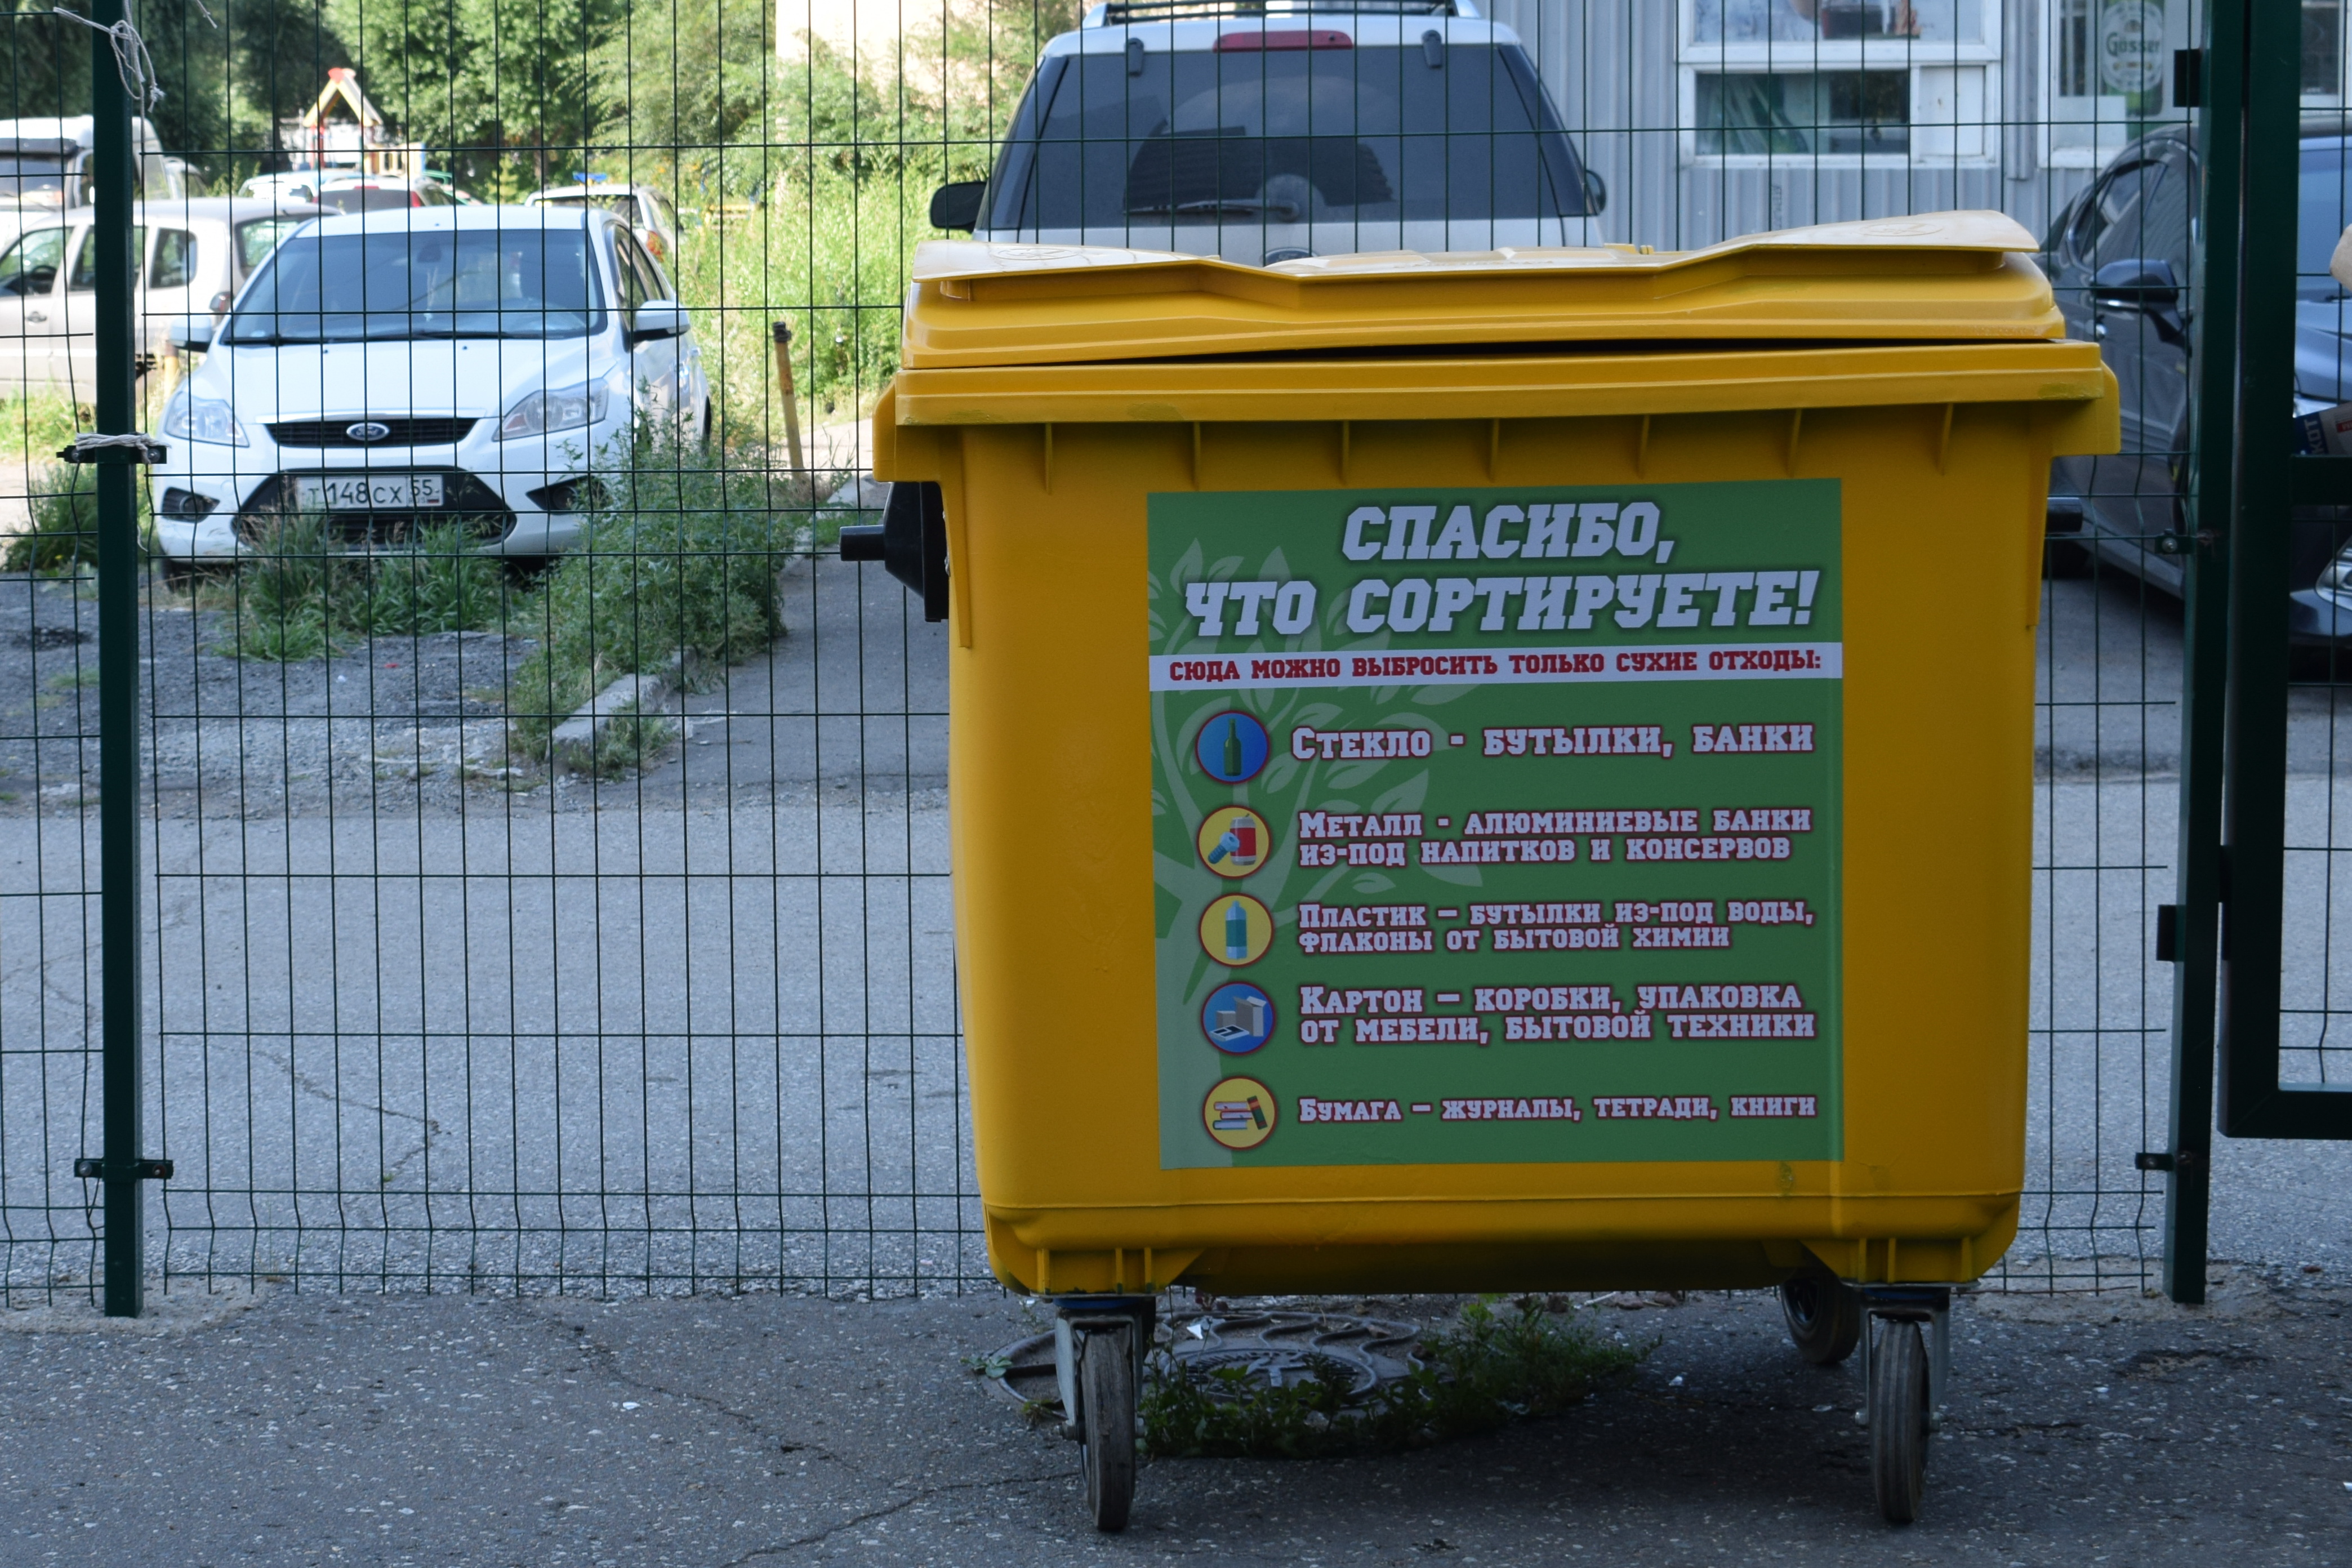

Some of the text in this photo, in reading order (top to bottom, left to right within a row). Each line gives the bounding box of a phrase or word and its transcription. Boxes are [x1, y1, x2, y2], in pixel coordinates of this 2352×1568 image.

[1342, 502, 1674, 564] СПАСИБО,
[1185, 570, 1819, 636] ЧТО СОРТИРУЕТЕ!
[1170, 649, 1821, 682] СЮДА МОЖНО ВЫБРОСИТЬ ТОЛЬКО СУХИЕ ОТХОДЫ:
